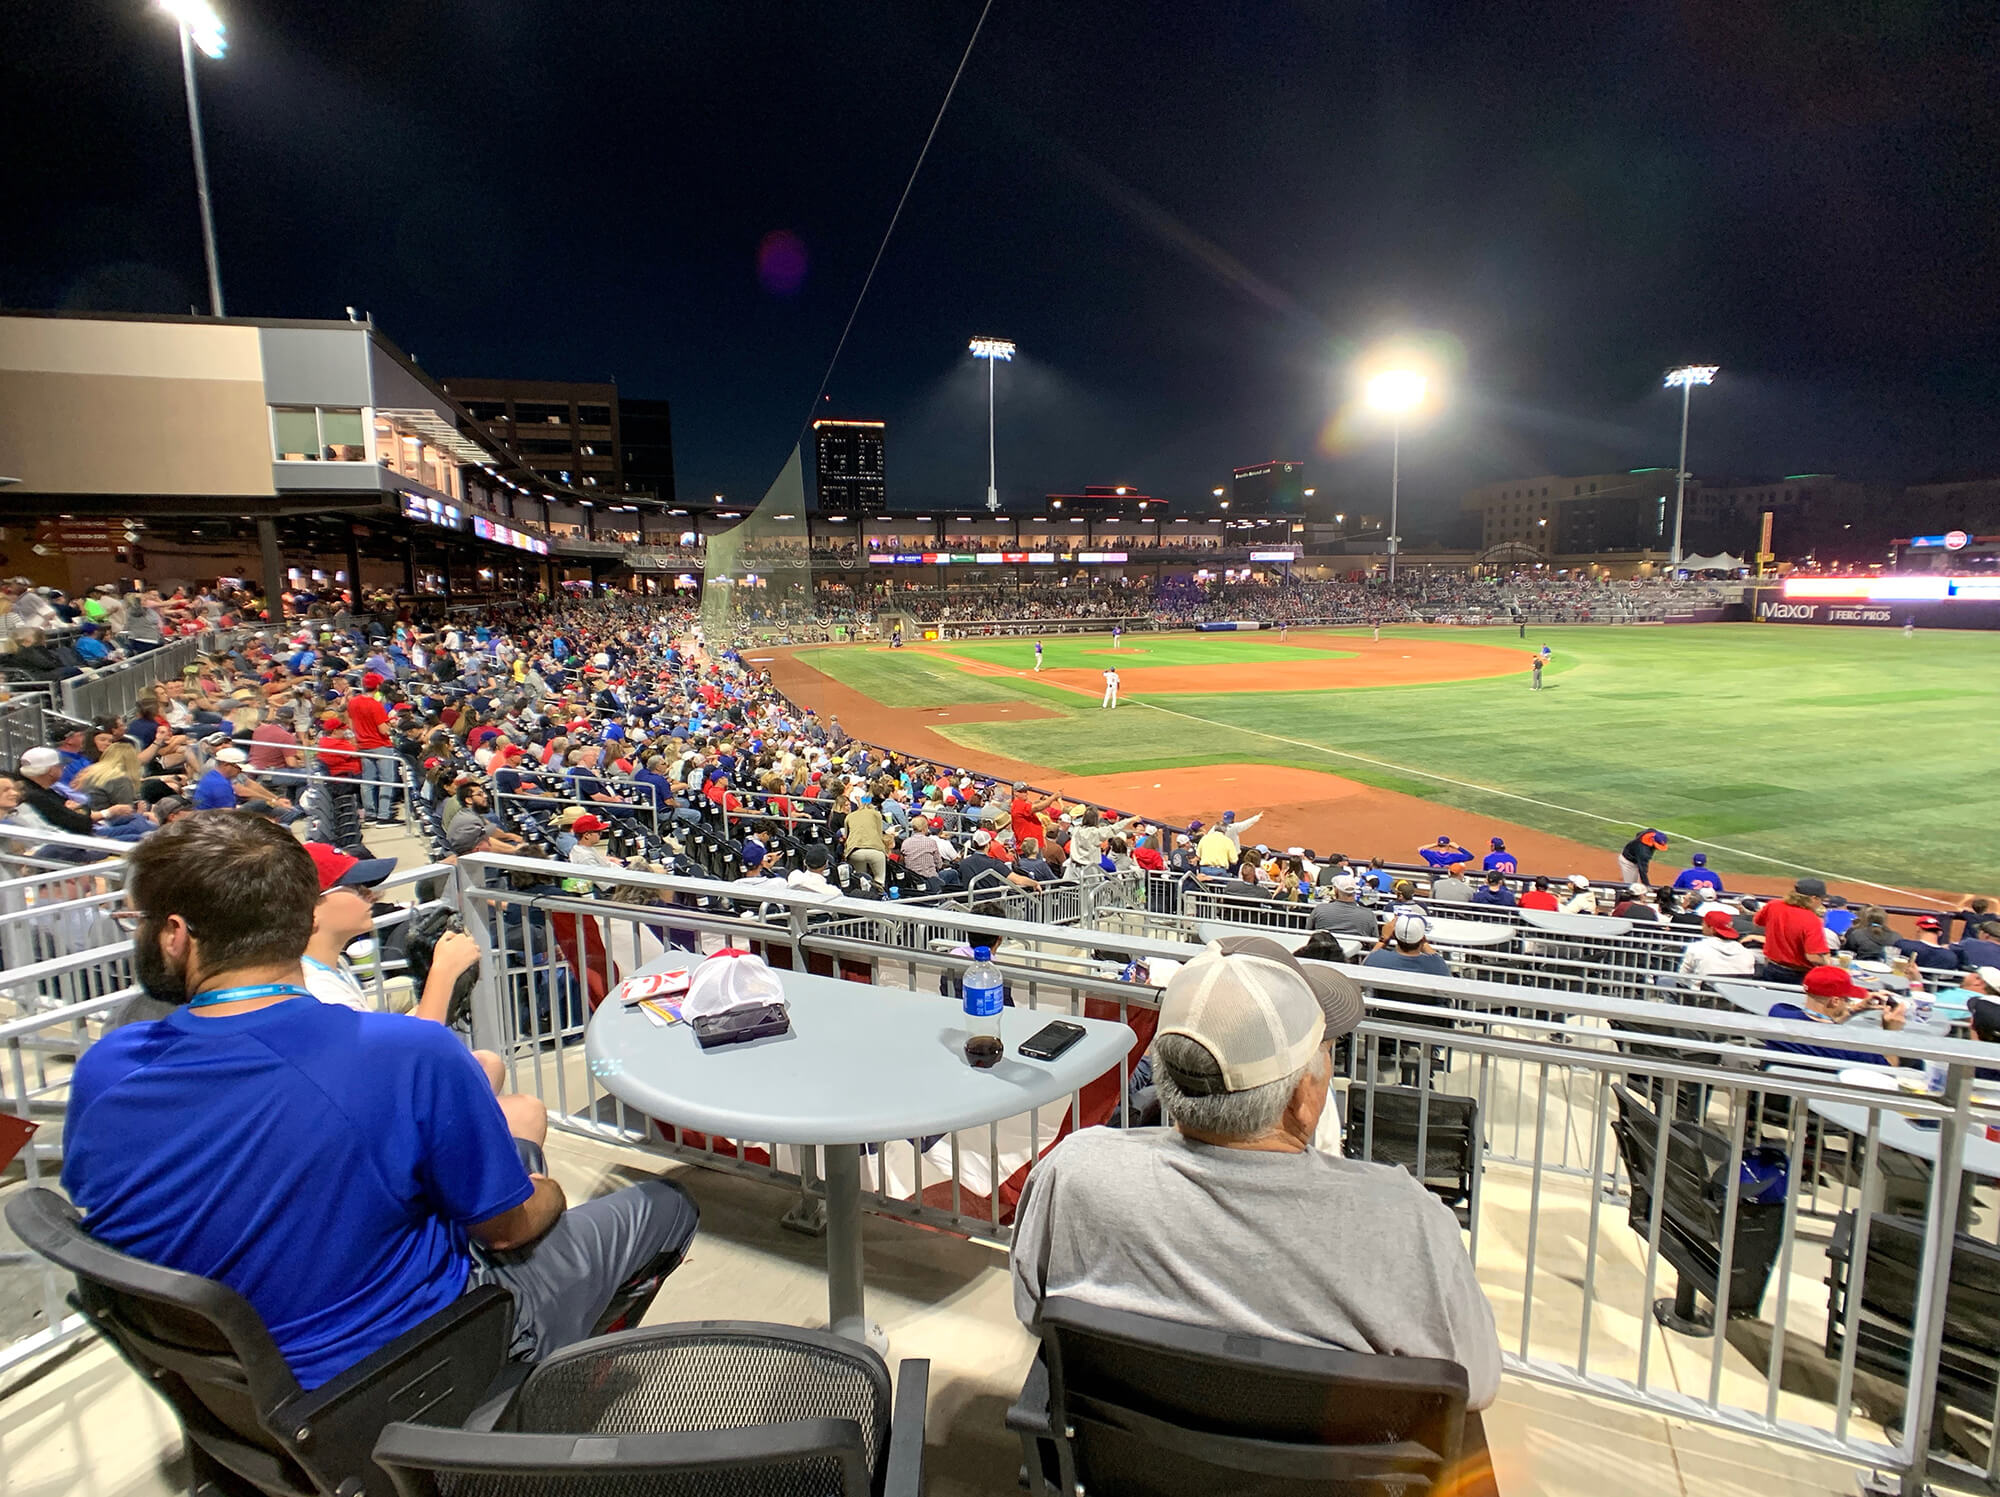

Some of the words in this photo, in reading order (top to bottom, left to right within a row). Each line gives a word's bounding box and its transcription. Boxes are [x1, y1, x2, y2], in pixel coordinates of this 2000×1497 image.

[1761, 601, 1819, 619] Maxor
[1829, 610, 1835, 621] J
[1836, 610, 1861, 620] FERG
[1863, 610, 1891, 621] PROS
[1495, 862, 1514, 874] 20
